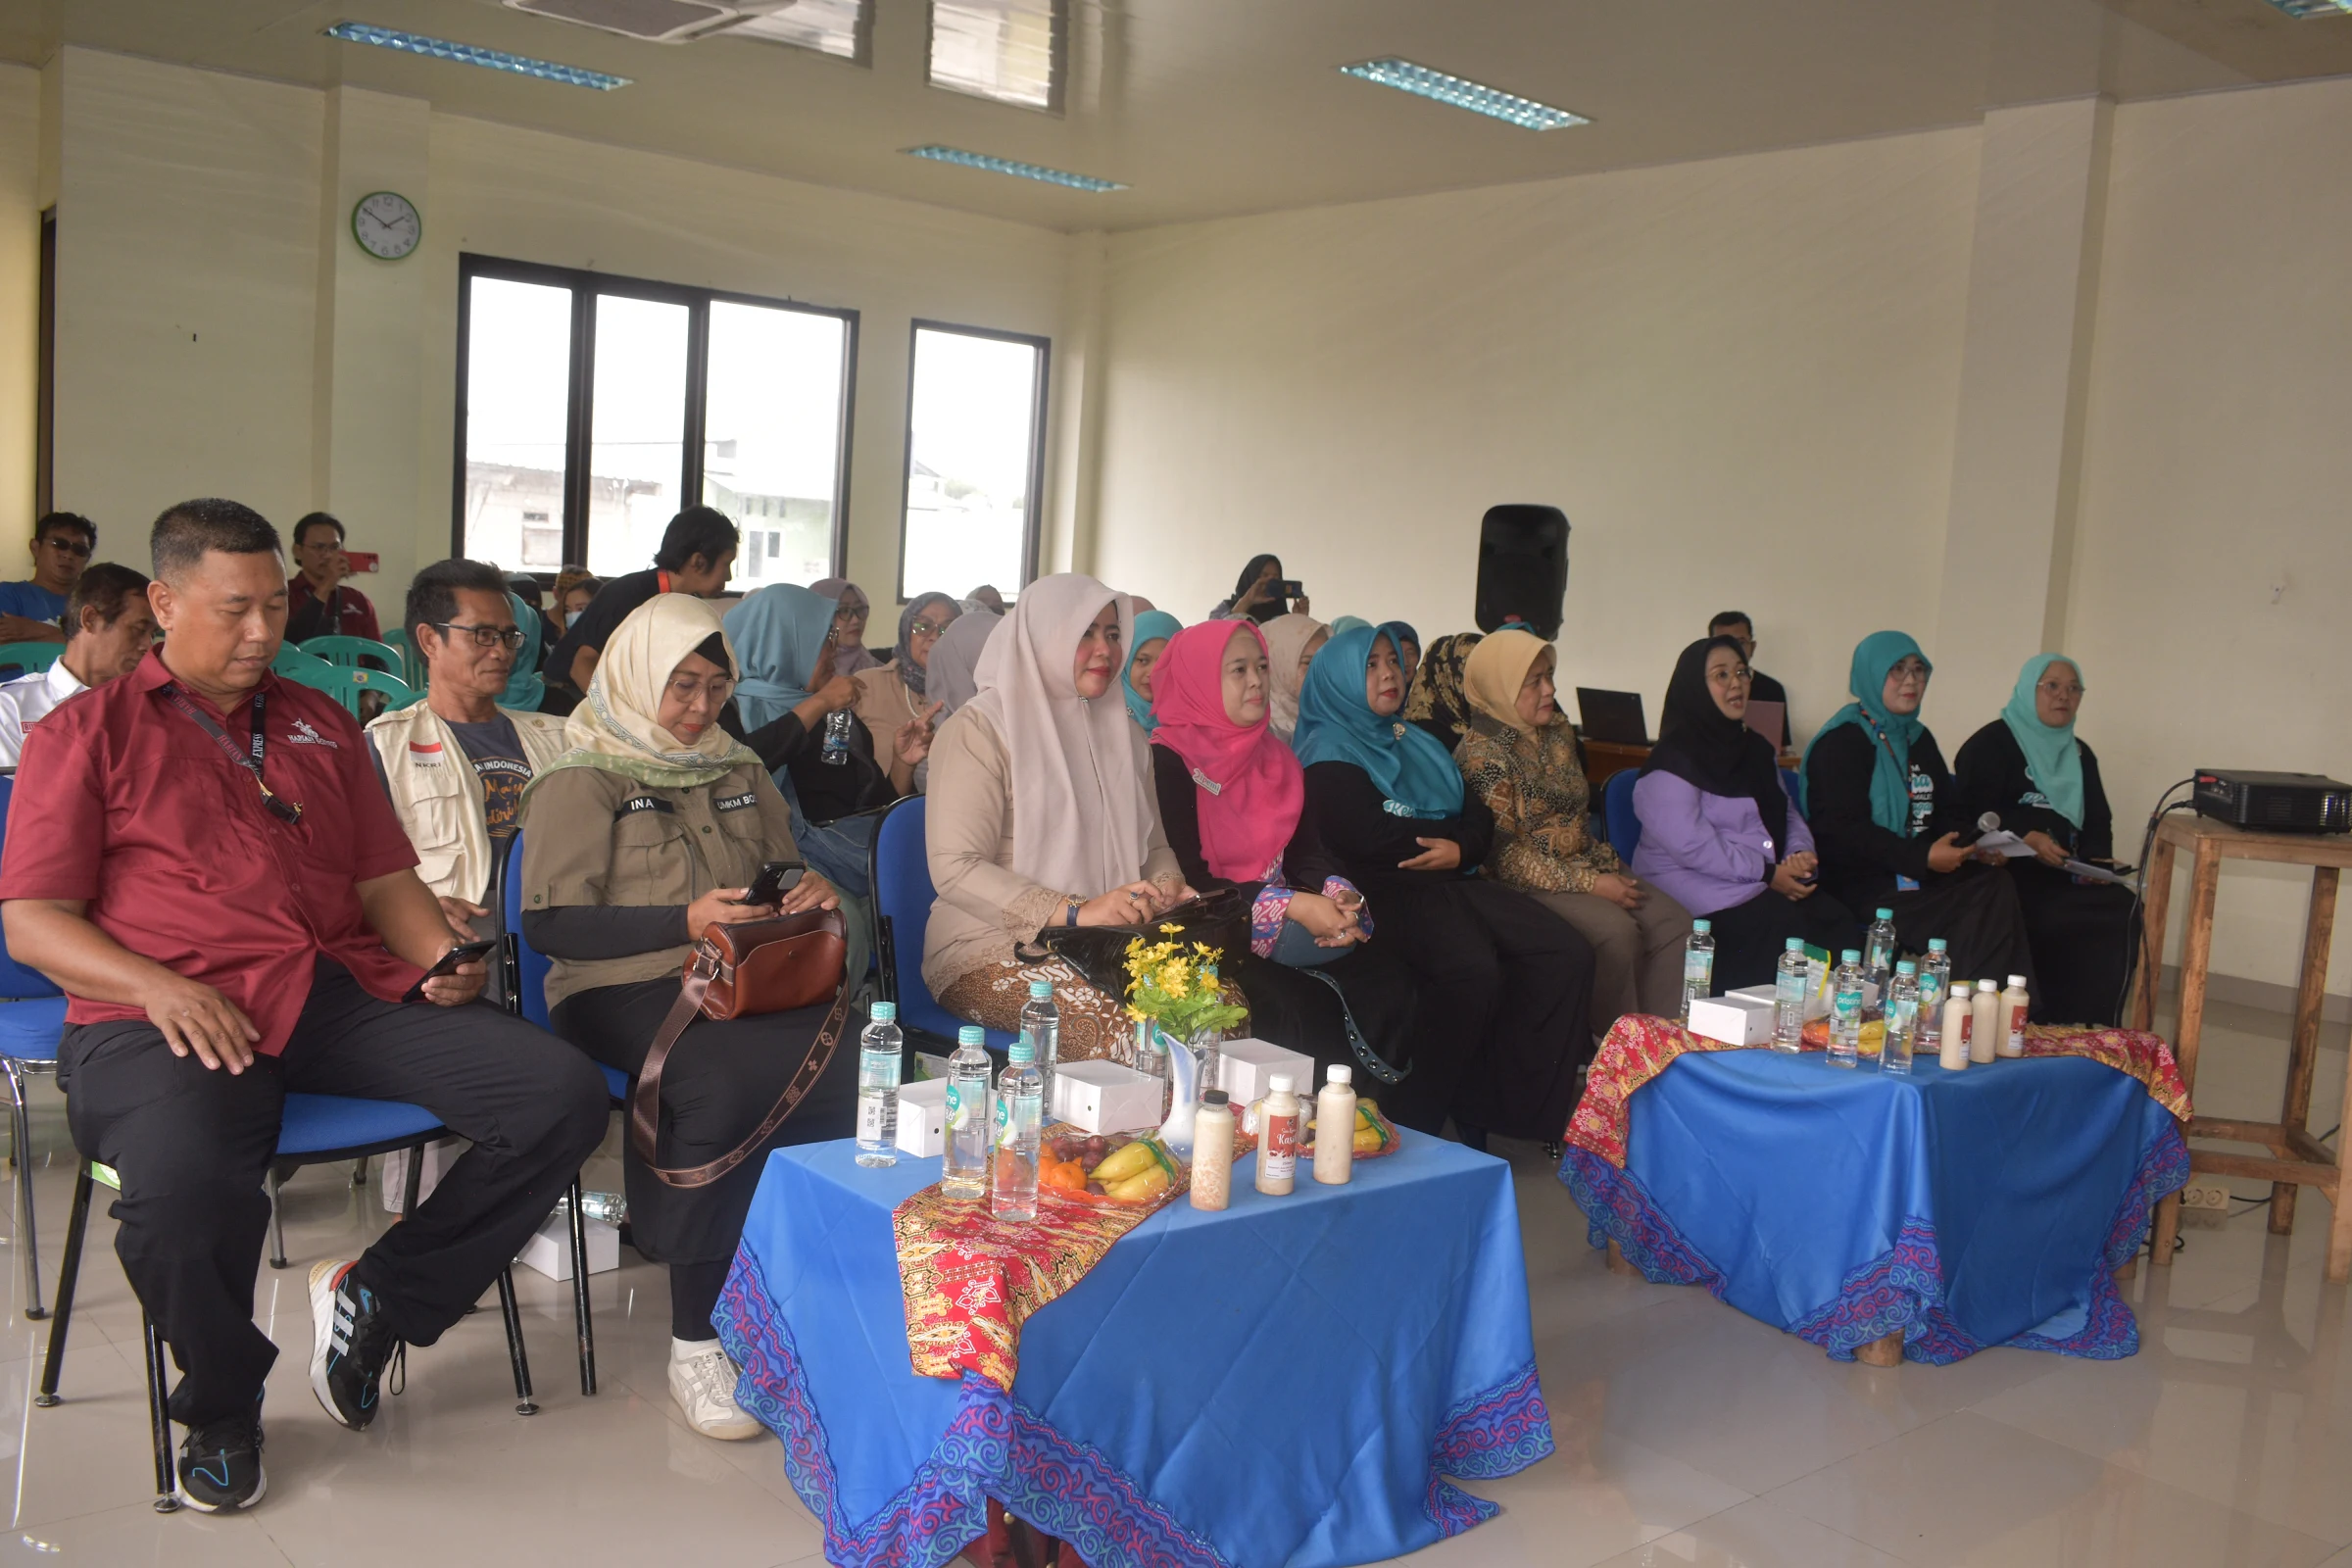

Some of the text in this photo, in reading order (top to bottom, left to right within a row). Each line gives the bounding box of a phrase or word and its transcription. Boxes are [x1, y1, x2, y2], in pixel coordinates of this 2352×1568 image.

[372, 198, 379, 208] 11
[383, 196, 393, 207] 12
[358, 218, 366, 226] 9
[404, 213, 413, 222] 2
[408, 224, 416, 235] 3
[361, 231, 368, 240] 8
[369, 240, 377, 249] 7
[403, 238, 411, 247] 4
[381, 246, 389, 256] 6
[287, 734, 316, 744] HARIAN
[217, 734, 243, 761] HARIAN
[252, 733, 264, 759] EXPRESS
[486, 760, 532, 778] INDONESIA
[630, 798, 655, 810] INA
[716, 797, 742, 809] UMKM
